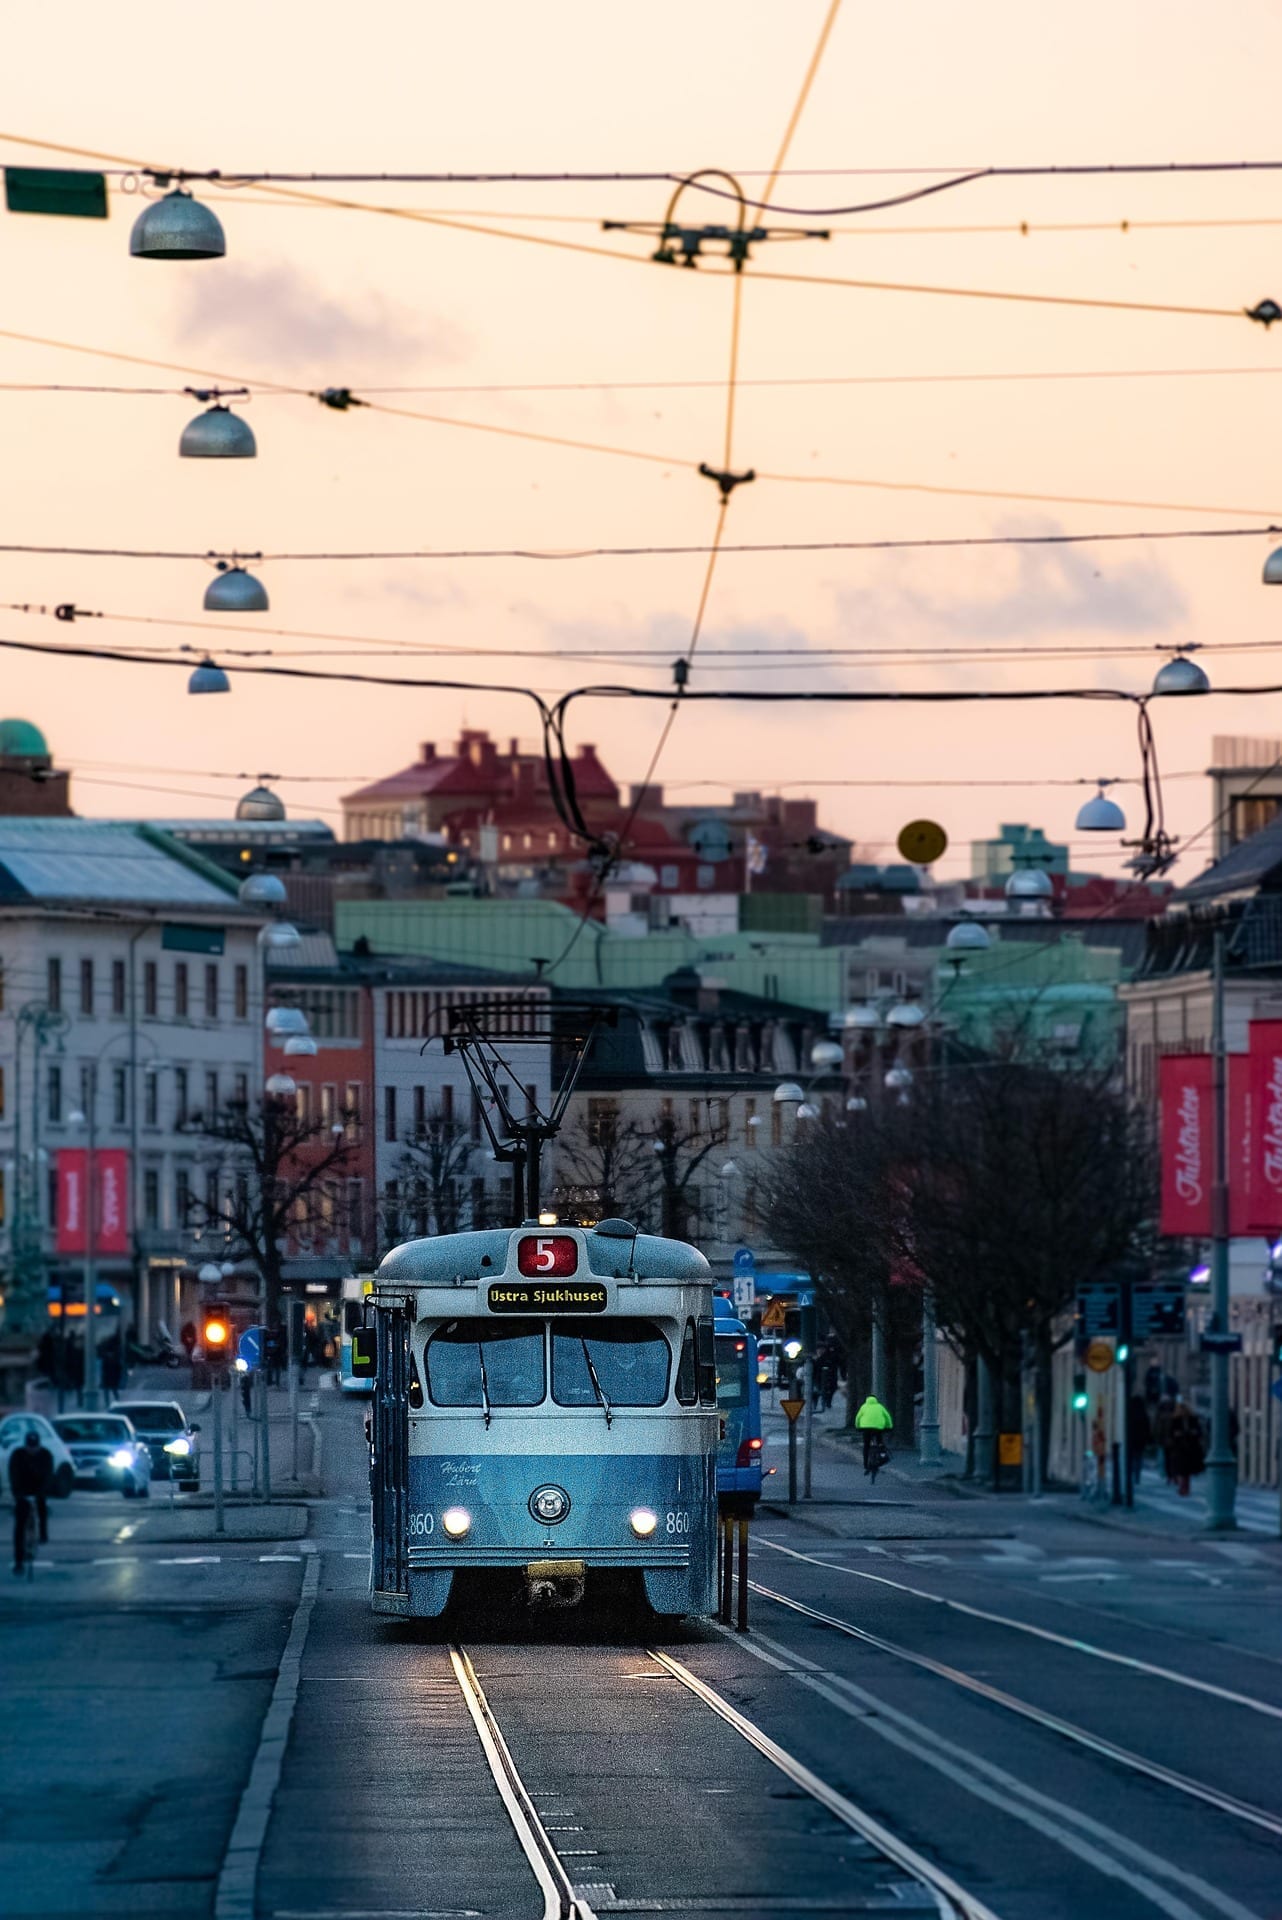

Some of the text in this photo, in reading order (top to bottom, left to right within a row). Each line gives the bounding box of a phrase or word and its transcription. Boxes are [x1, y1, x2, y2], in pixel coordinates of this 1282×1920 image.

[536, 1239, 556, 1271] 5
[533, 1289, 604, 1304] Sjukhuset
[410, 1513, 434, 1535] 860
[666, 1512, 690, 1534] 860
